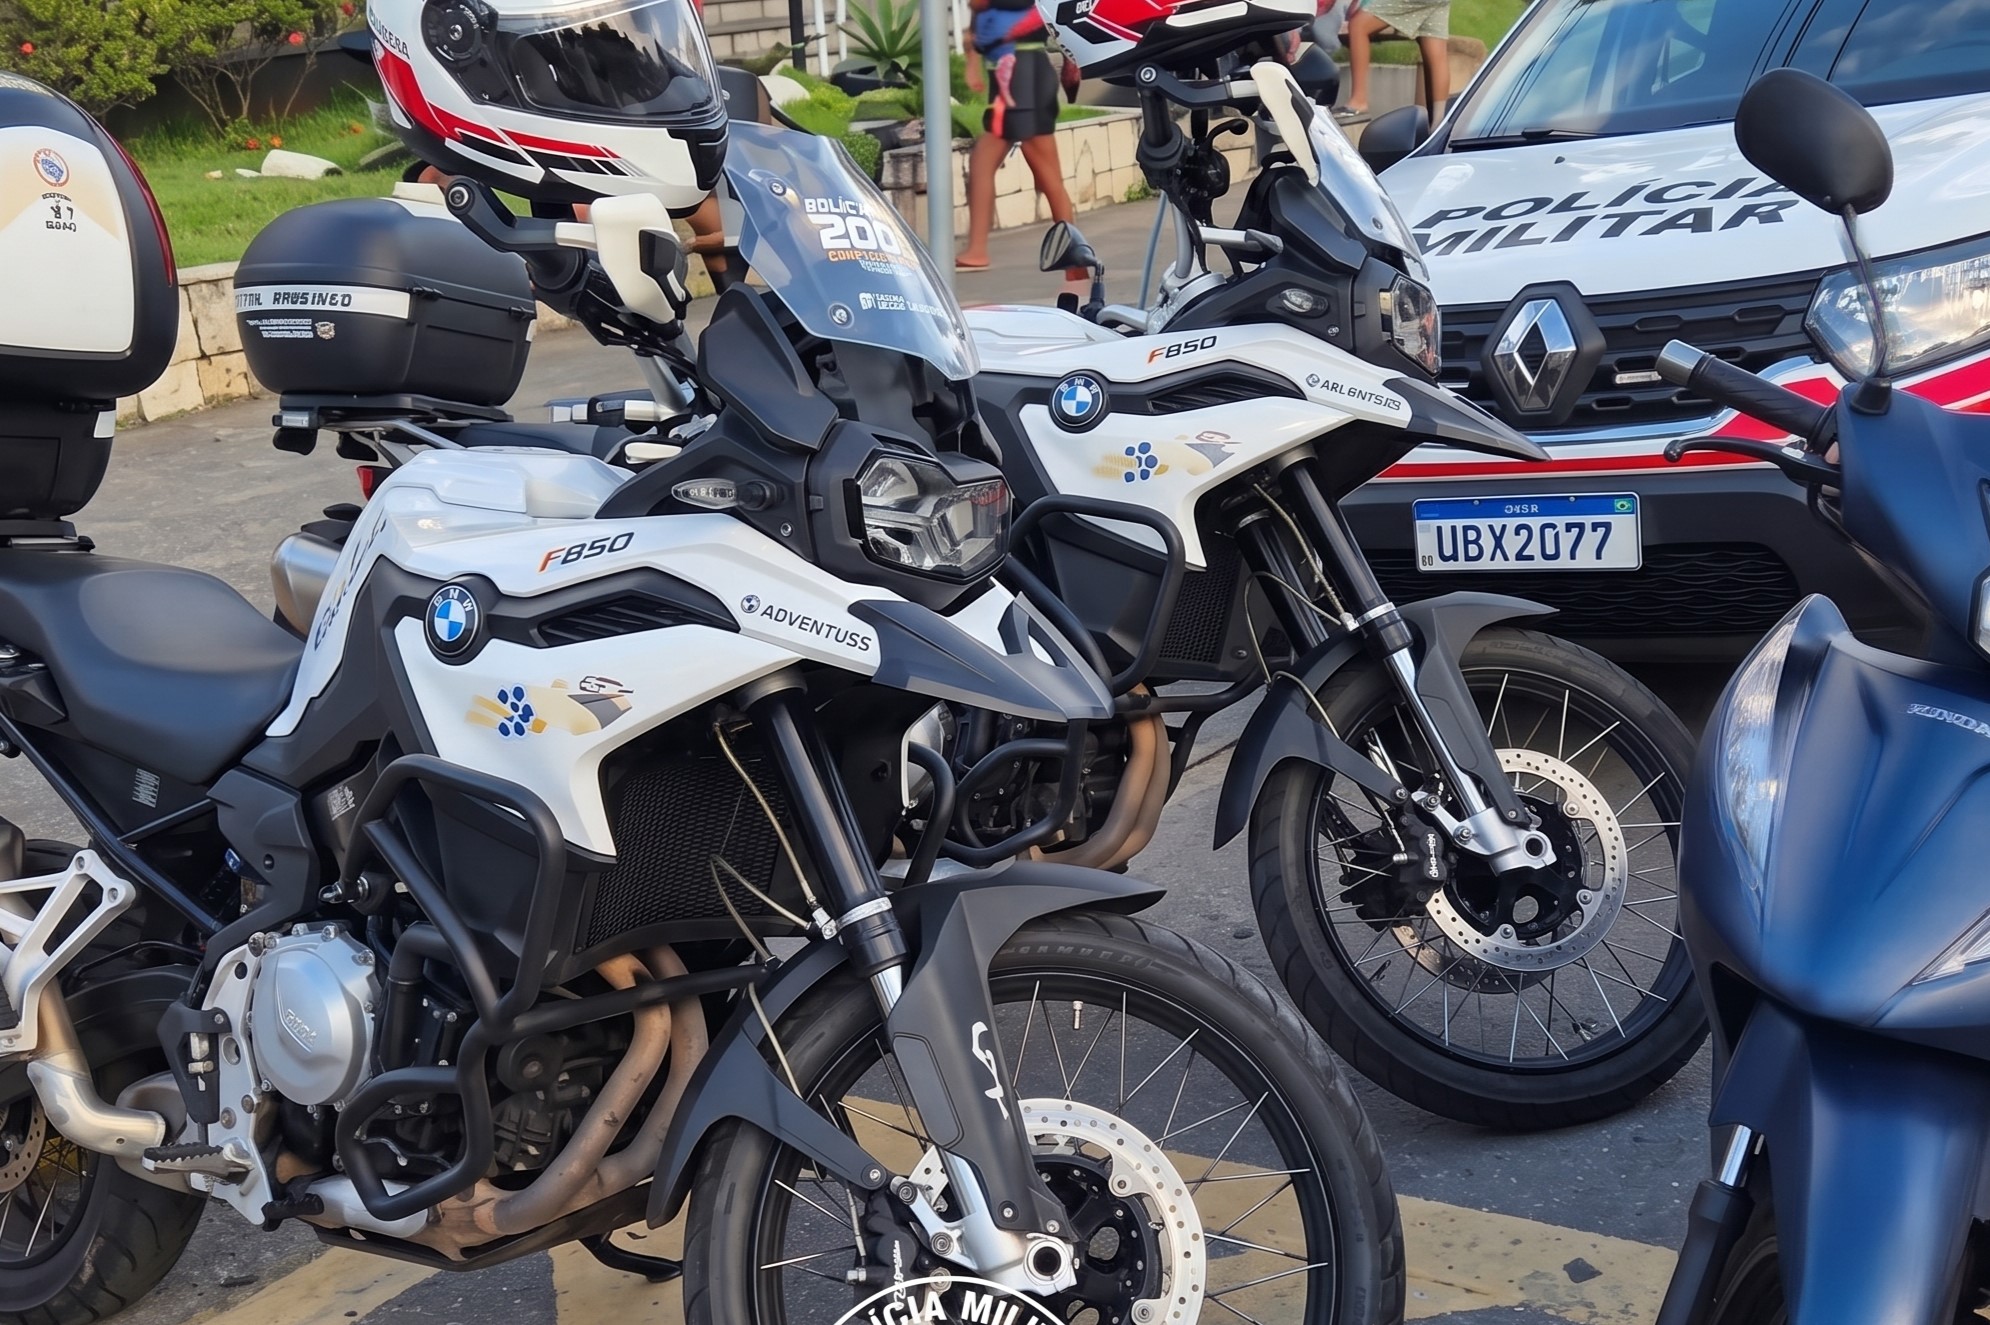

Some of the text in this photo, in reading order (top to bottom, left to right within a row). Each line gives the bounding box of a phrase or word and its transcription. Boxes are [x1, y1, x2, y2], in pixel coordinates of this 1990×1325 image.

[807, 214, 902, 255] 200
[1412, 199, 1799, 257] MILITAR
[1147, 335, 1218, 364] F850
[538, 531, 635, 573] F850
[760, 604, 872, 652] ADVENTUSS
